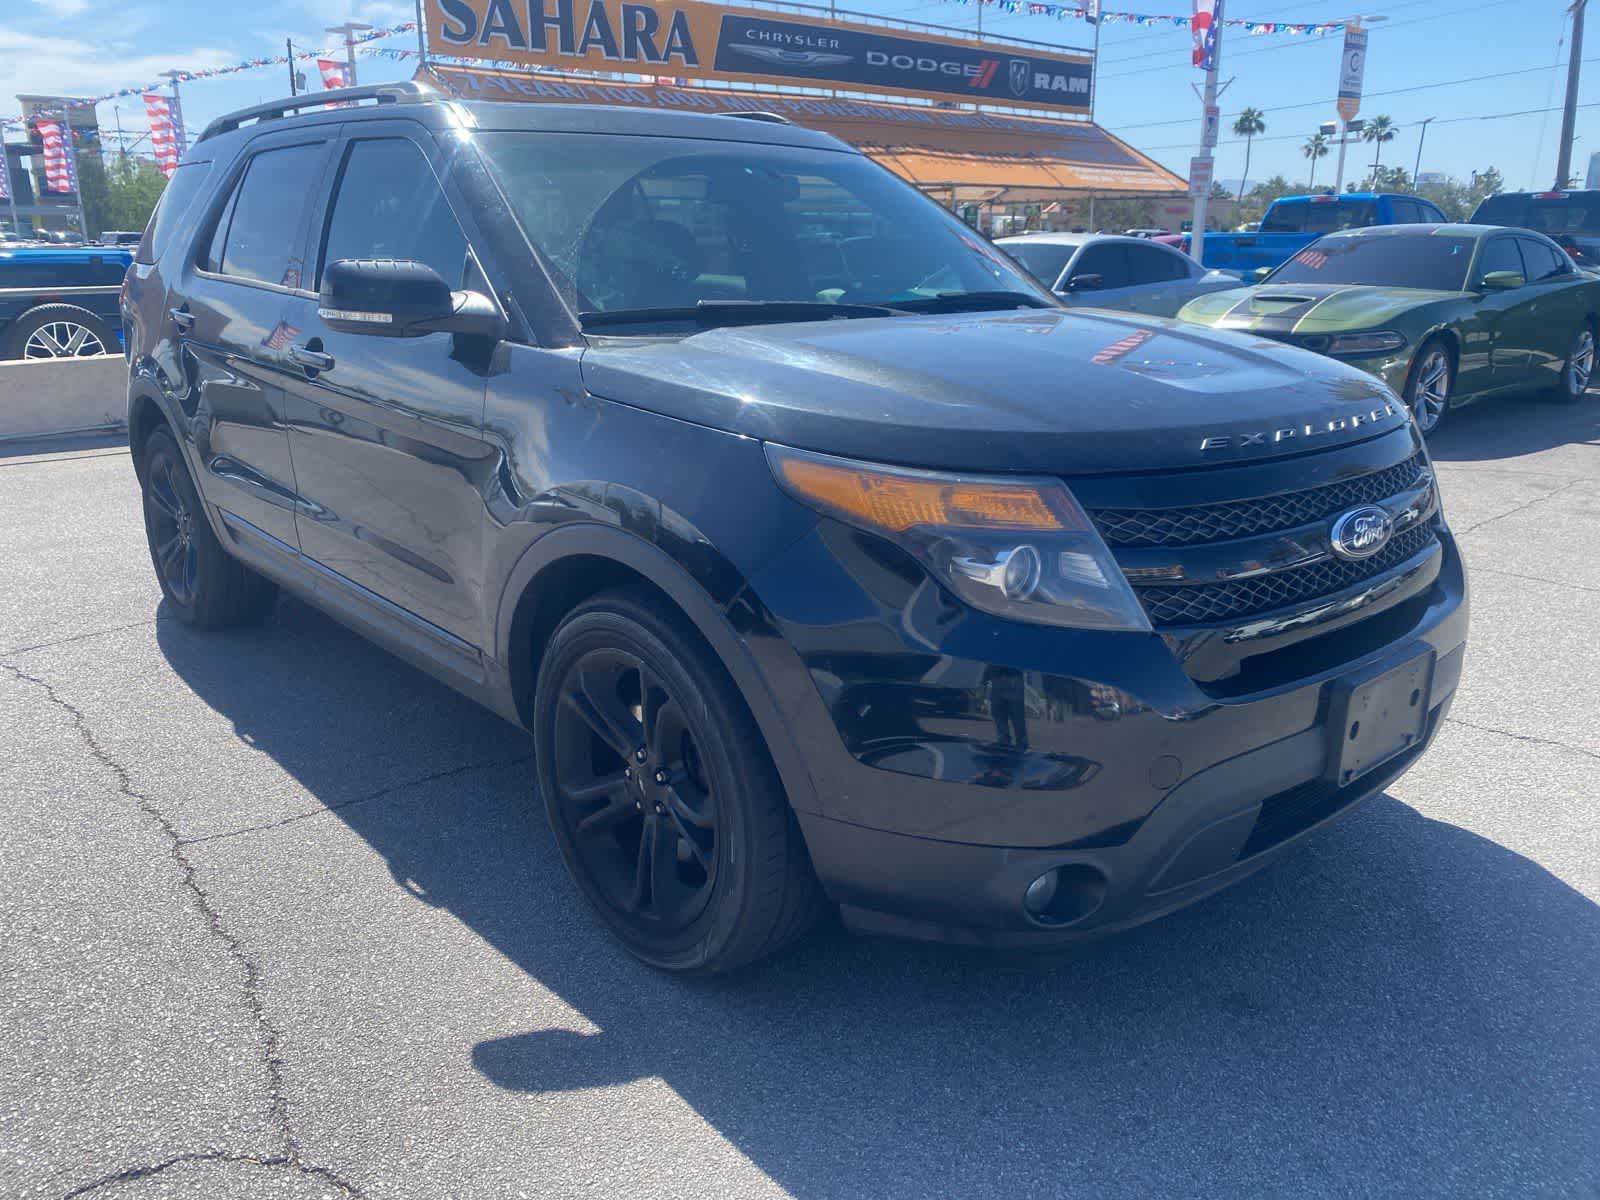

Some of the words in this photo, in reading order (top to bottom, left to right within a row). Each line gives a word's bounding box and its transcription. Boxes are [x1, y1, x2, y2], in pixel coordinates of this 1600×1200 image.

[435, 0, 699, 68] SAHARA
[745, 28, 840, 49] CHRYSLER
[865, 50, 984, 78] DODGE
[1033, 72, 1089, 94] RAM
[1200, 404, 1400, 451] EXPLORER
[1352, 516, 1386, 549] Ford
